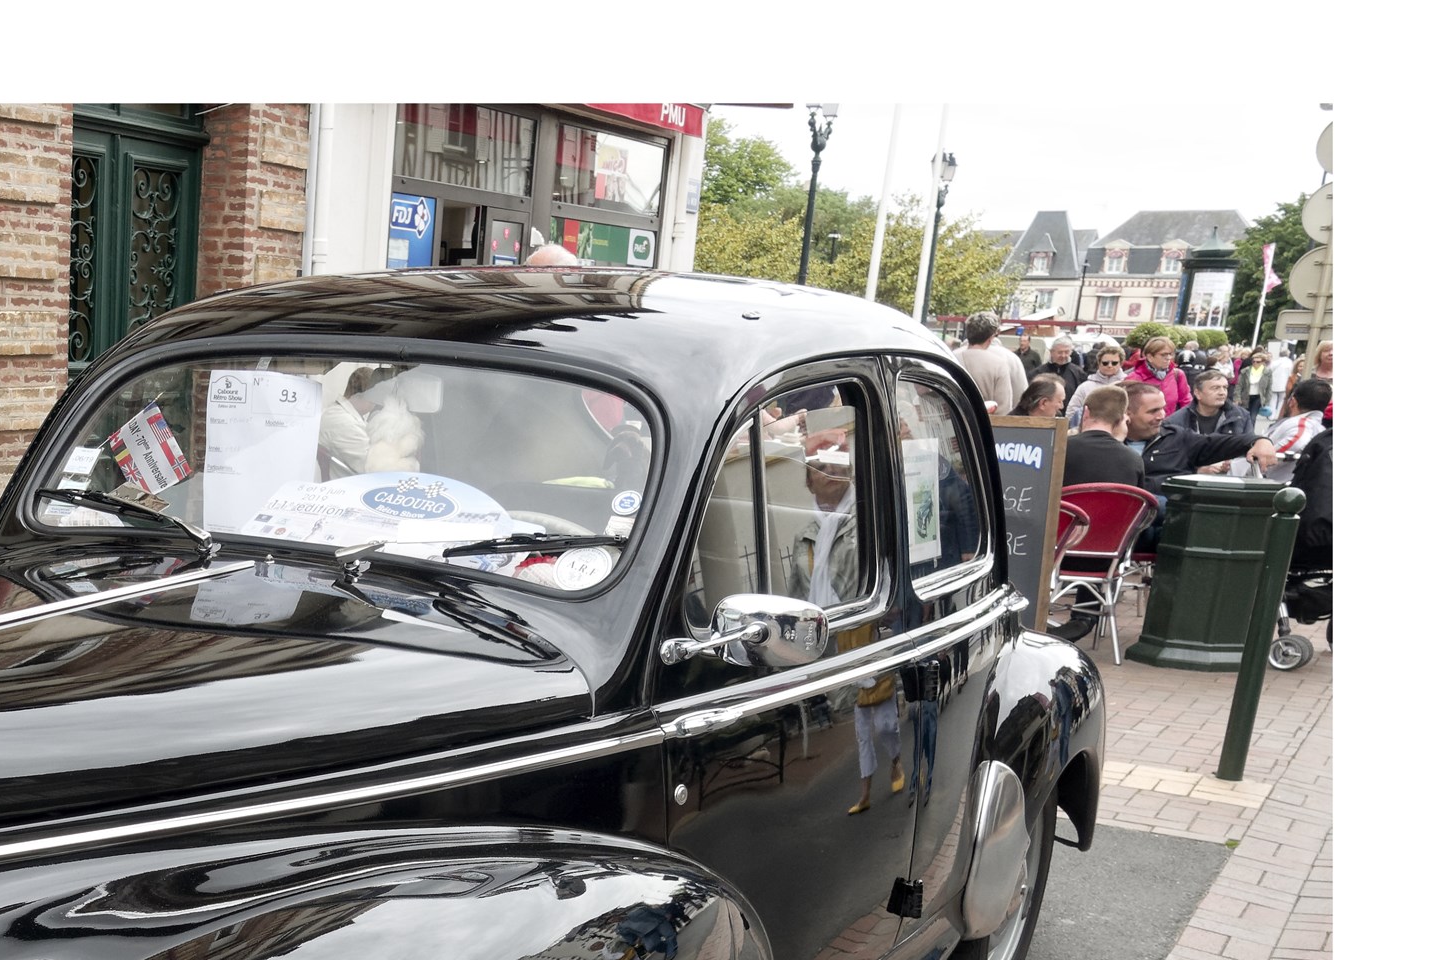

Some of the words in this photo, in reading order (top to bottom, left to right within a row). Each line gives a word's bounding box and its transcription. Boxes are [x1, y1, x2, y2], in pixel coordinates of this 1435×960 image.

[660, 103, 686, 127] PMU
[392, 206, 412, 225] FDJ
[217, 388, 239, 396] Cabourg
[278, 389, 298, 403] 93
[994, 442, 1043, 469] NGINA
[142, 450, 168, 489] Anniversaire
[302, 493, 328, 501] 2019
[326, 487, 346, 495] juin
[374, 491, 447, 514] CABOURG
[375, 504, 400, 516] Rétro
[399, 509, 426, 519] Show
